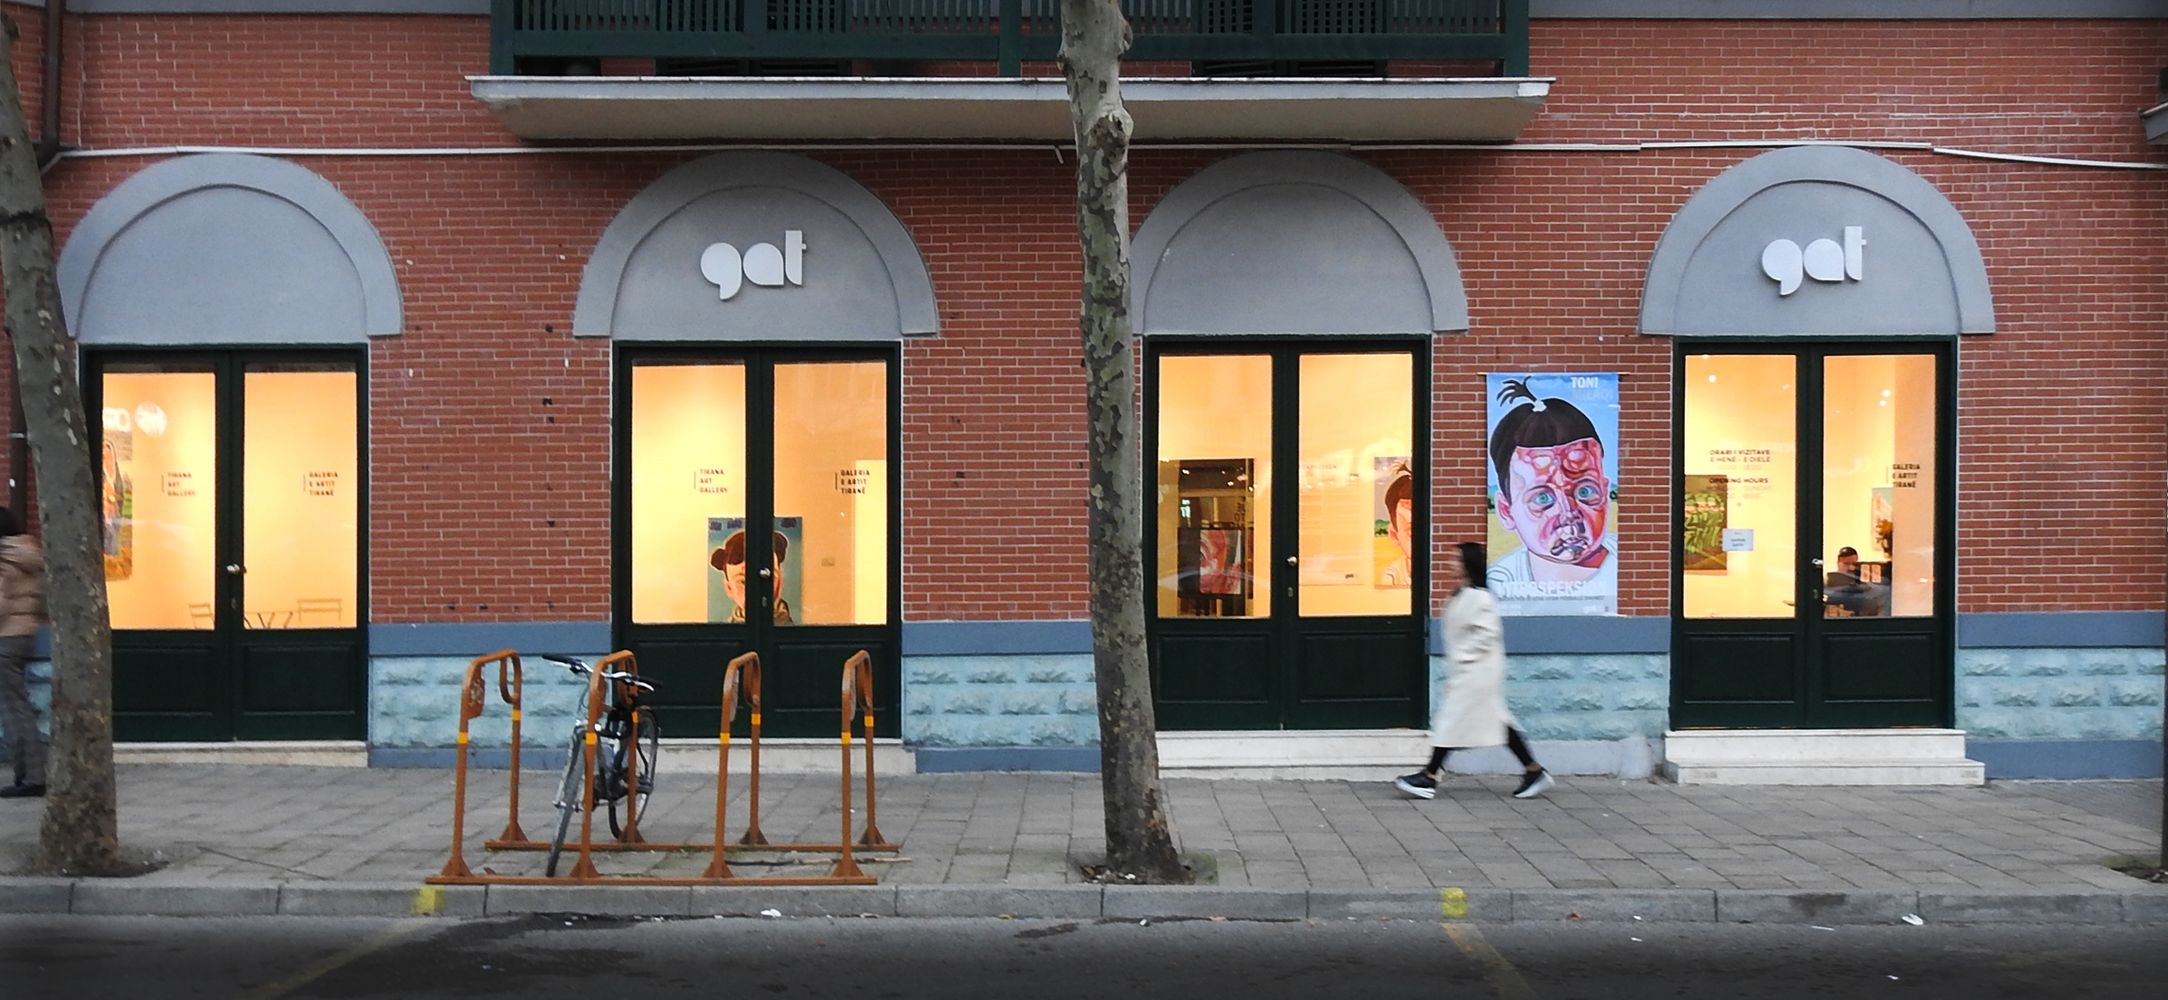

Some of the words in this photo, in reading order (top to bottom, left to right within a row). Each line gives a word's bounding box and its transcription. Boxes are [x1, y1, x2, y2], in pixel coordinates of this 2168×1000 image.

[701, 230, 806, 300] gat
[1762, 226, 1866, 296] gat
[1571, 376, 1599, 388] TONI
